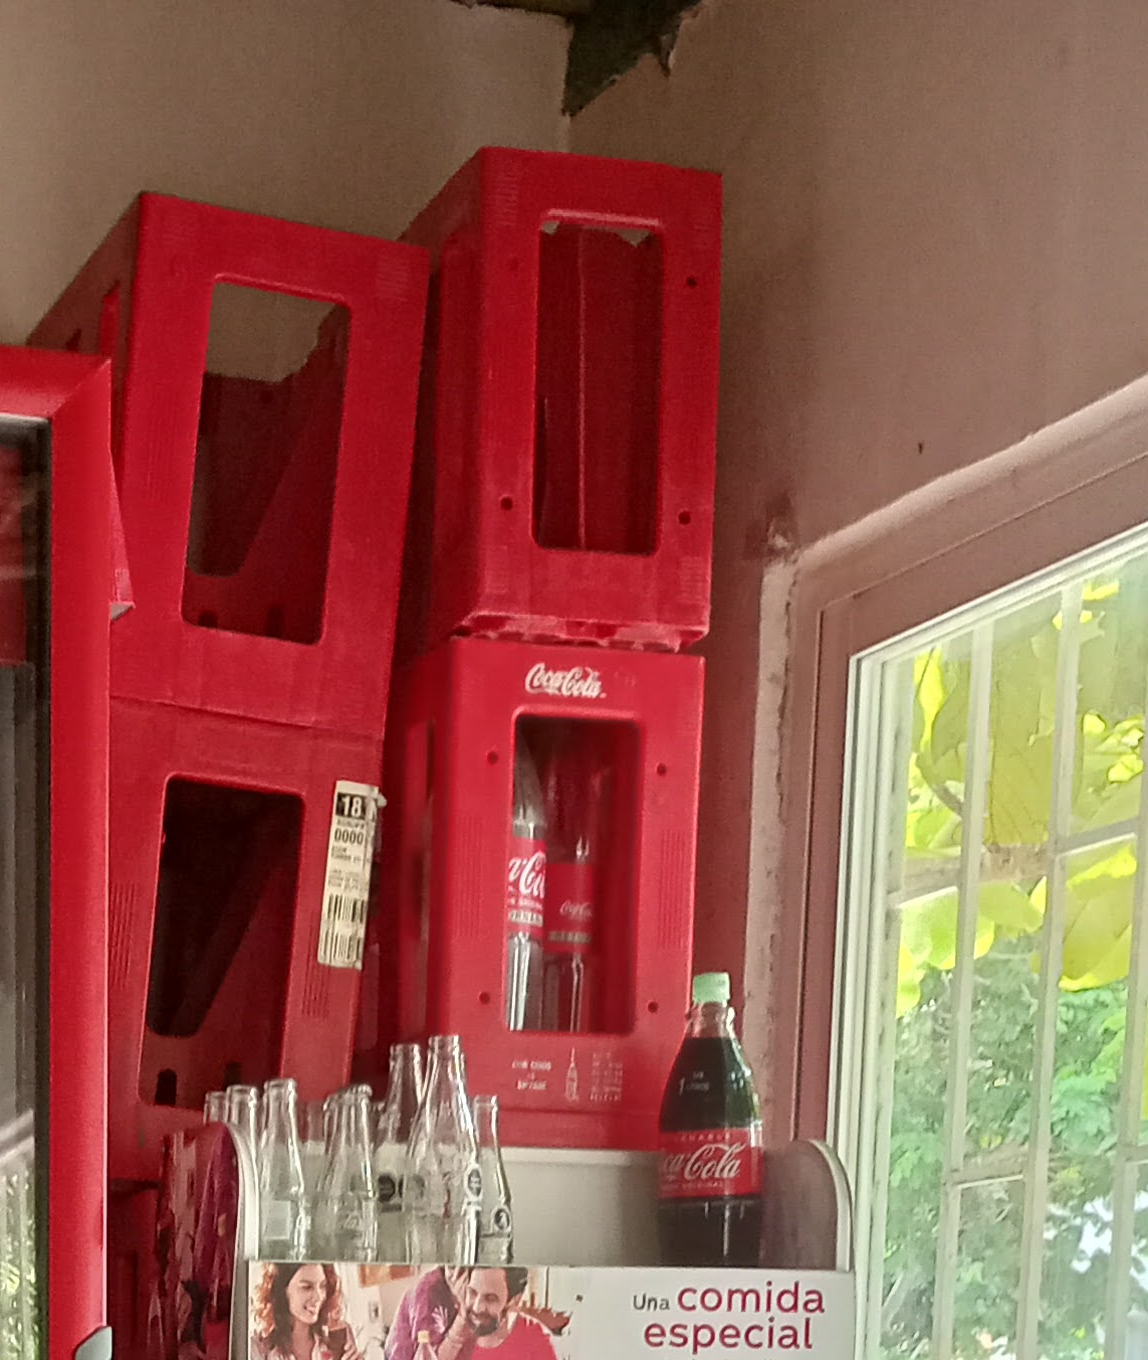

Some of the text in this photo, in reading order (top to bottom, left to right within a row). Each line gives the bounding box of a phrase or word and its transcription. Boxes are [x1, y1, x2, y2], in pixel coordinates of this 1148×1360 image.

[524, 662, 607, 699] Coca-Cola
[341, 796, 364, 817] 18
[333, 828, 365, 845] 0000
[663, 1142, 747, 1181] ca-Cola
[632, 1280, 826, 1313] Una comida
[643, 1316, 813, 1355] especial
